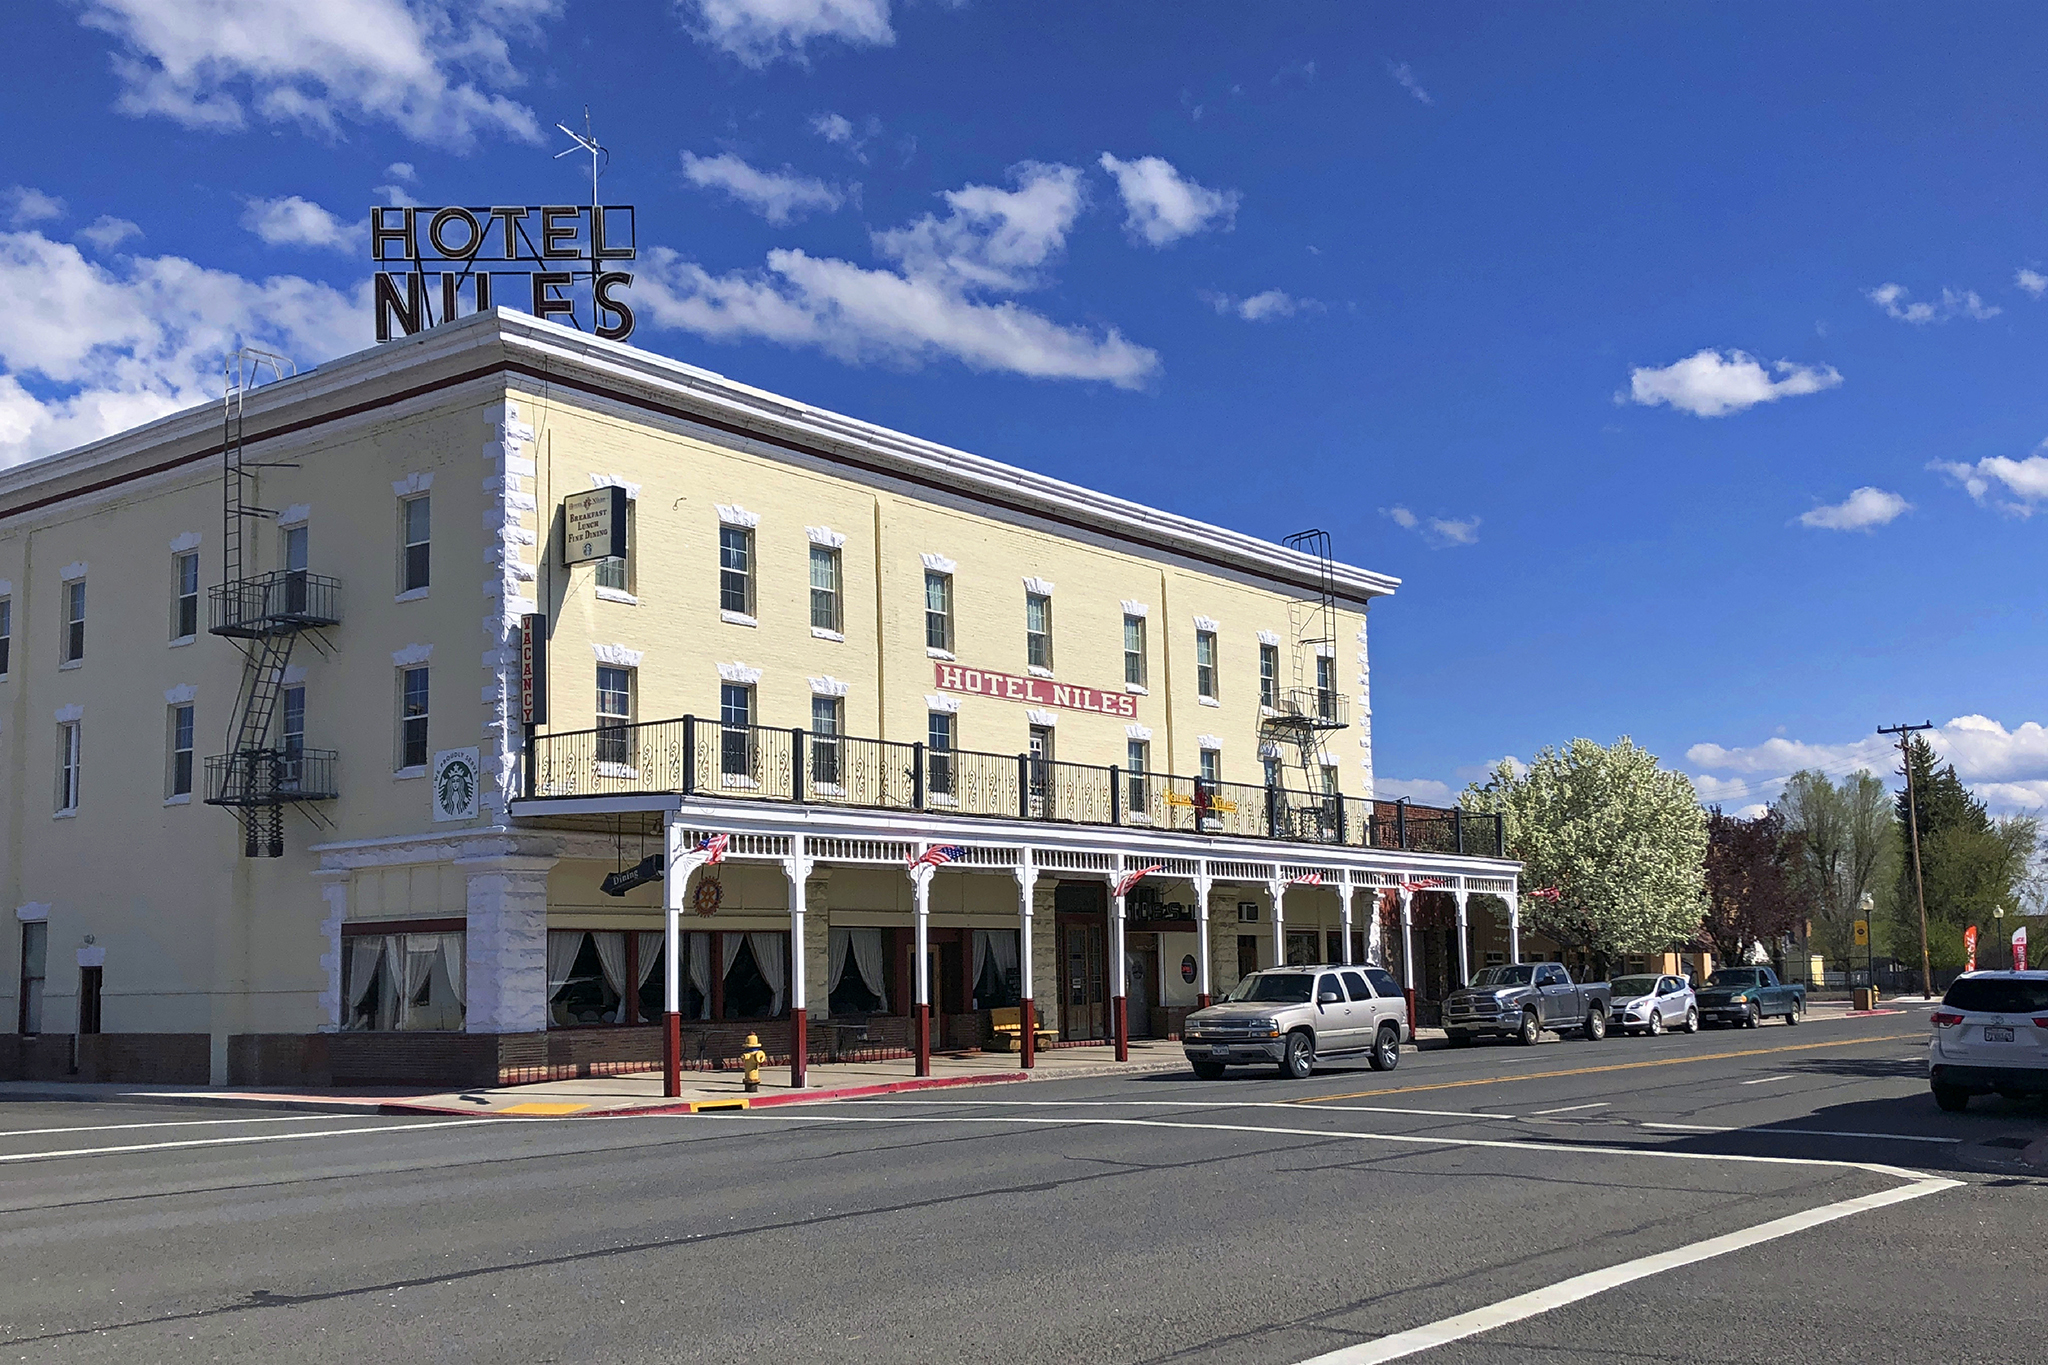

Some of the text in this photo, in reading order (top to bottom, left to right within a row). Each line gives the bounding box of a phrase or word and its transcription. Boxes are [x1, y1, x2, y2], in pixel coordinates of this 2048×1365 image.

[370, 205, 636, 260] HOTEL
[570, 509, 607, 523] BREAKFAST
[578, 521, 599, 531] LUNCH
[568, 529, 608, 543] FINE DINING
[522, 616, 534, 722] VACANCY
[941, 665, 1134, 716] HOTEL NILES
[440, 752, 464, 768] PROUDLY
[465, 755, 478, 775] SERVE
[613, 869, 639, 886] Dining
